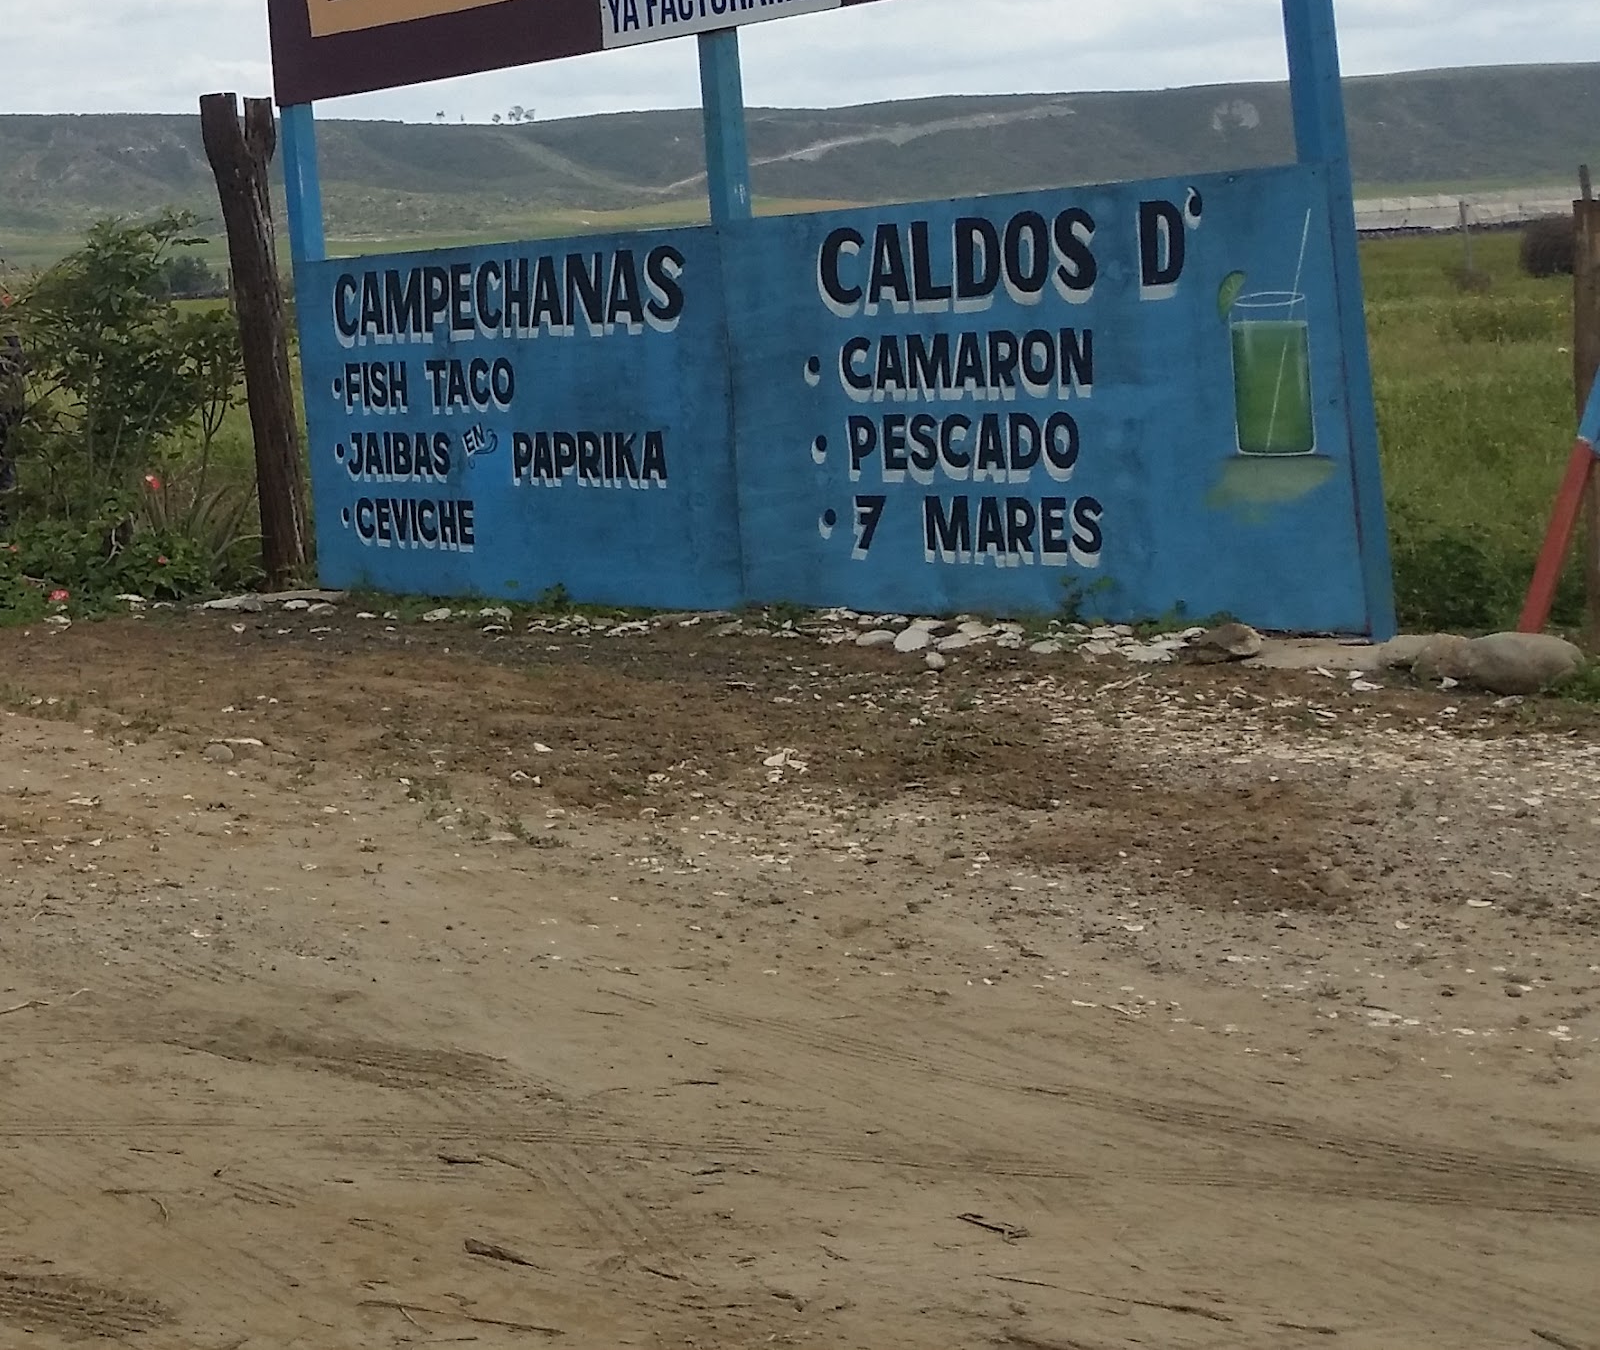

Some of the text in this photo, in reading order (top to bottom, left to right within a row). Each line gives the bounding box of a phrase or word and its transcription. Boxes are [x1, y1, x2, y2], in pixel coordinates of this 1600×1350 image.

[333, 245, 685, 348] CAMPECHANAS
[817, 207, 1097, 317] CALDOS
[344, 357, 515, 415] FISH TACO
[839, 328, 1093, 403] CAMARON
[347, 422, 668, 489] JAIBAS EN PAPRIKA
[846, 411, 1079, 484] PESCADO
[354, 497, 474, 552] CEVICHE
[851, 495, 1103, 568] 7 MARES
